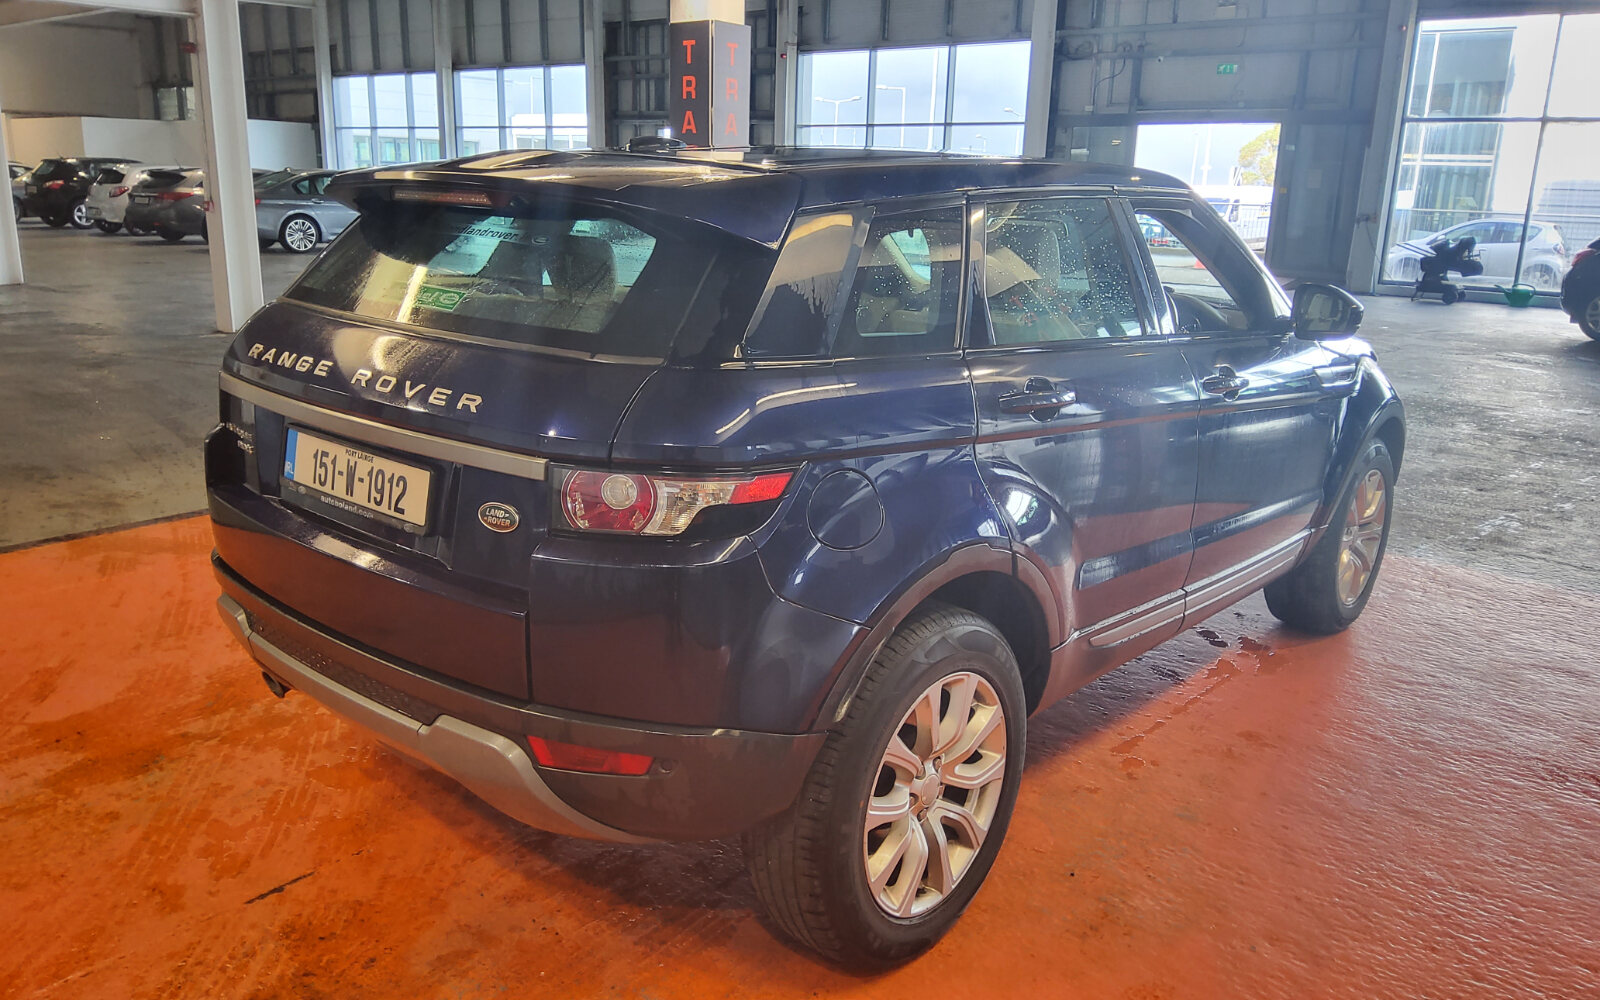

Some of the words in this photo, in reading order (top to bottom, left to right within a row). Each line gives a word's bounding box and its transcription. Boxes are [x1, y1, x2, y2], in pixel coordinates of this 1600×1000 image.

[682, 39, 698, 148] TRA
[725, 42, 739, 150] TRA
[247, 342, 334, 378] RANGE
[350, 368, 483, 413] ROVER
[312, 448, 408, 516] 151-W-1912
[487, 516, 511, 527] ROVER
